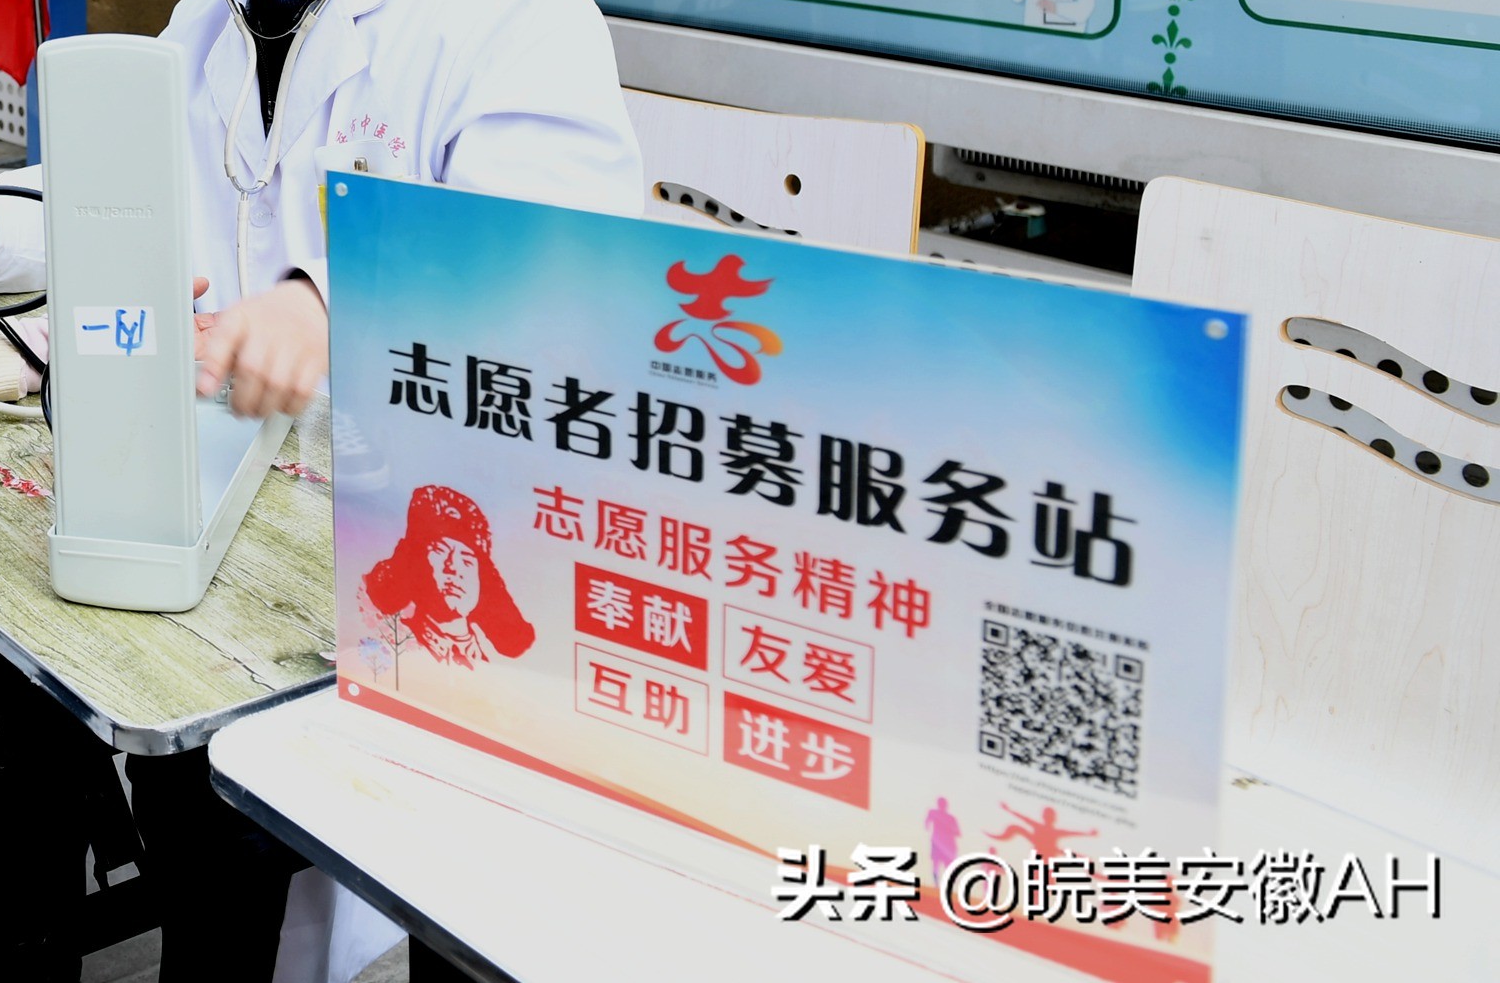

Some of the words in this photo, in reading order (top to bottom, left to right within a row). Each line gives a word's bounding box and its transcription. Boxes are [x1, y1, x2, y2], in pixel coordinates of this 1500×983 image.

[387, 342, 1140, 590] 志愿者招募服务站
[530, 483, 934, 642] 志愿服务精神
[585, 577, 694, 653] 奉献
[587, 658, 692, 736] 互助
[739, 623, 859, 708] 友爱
[736, 707, 857, 785] 进步
